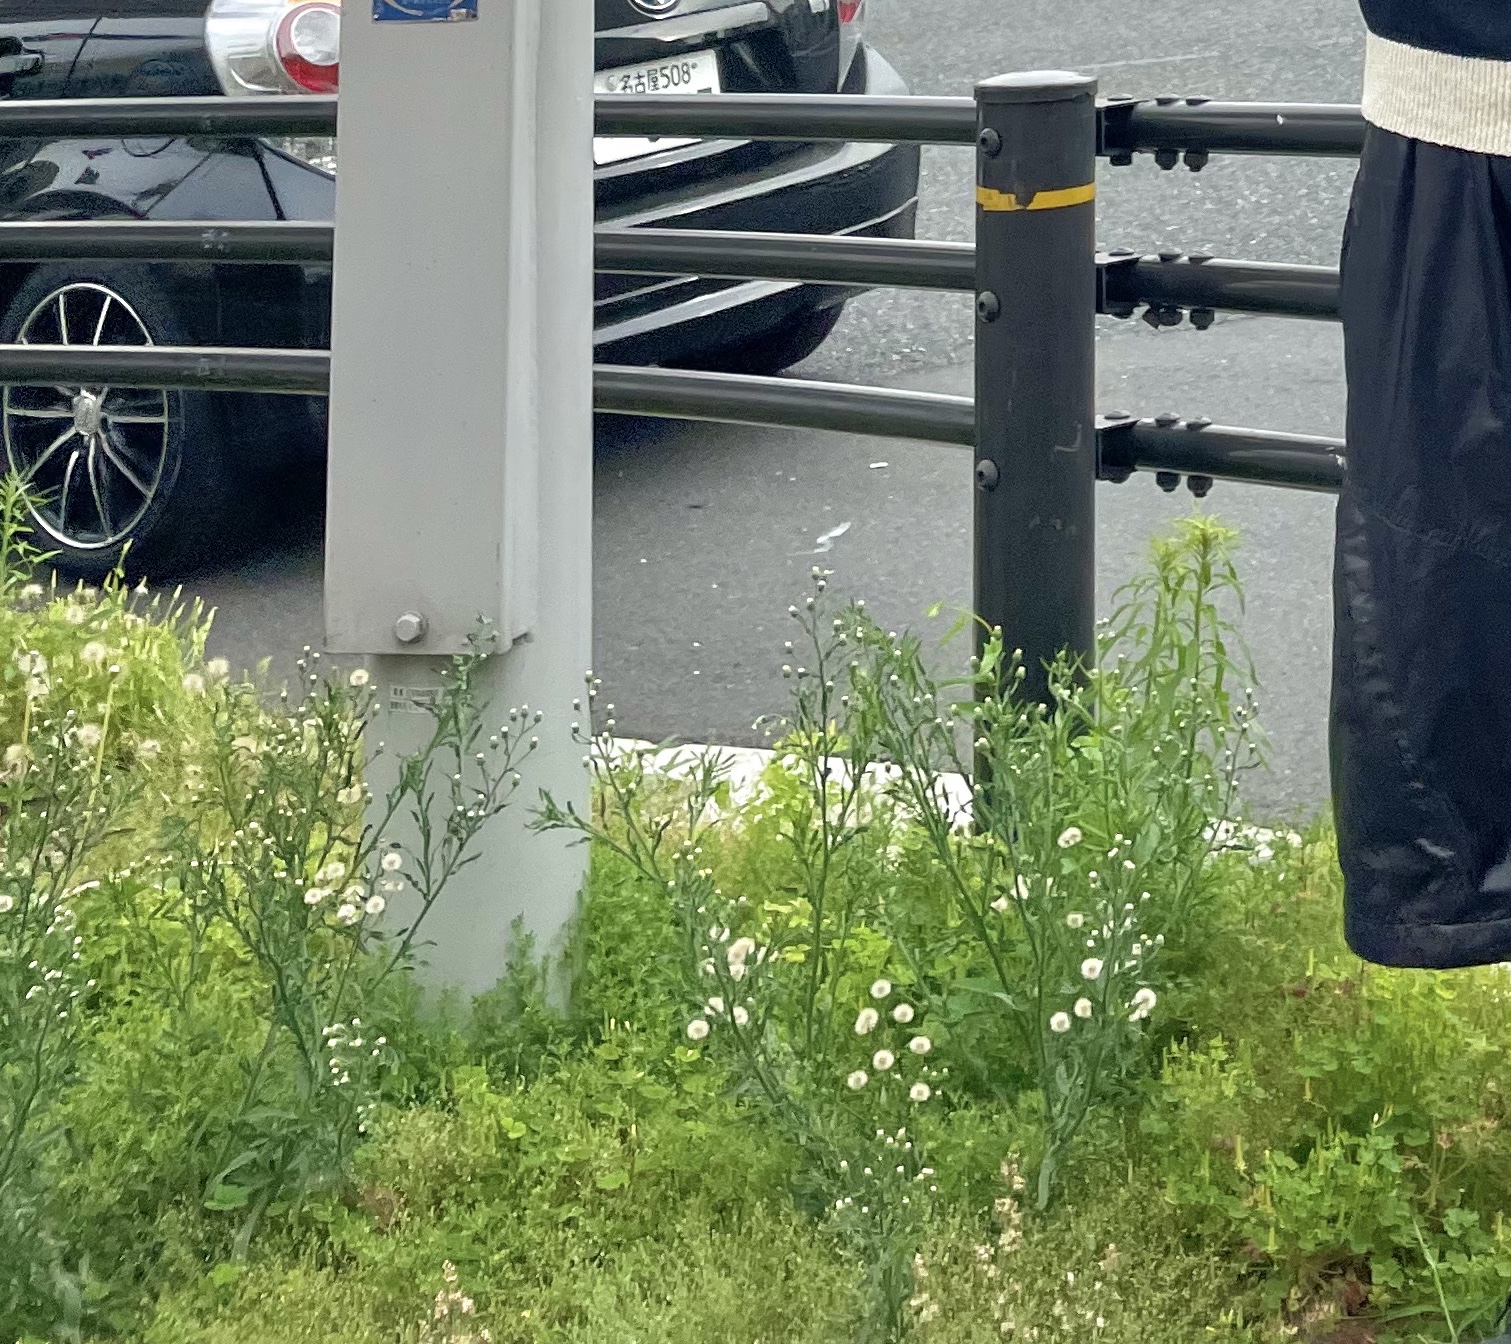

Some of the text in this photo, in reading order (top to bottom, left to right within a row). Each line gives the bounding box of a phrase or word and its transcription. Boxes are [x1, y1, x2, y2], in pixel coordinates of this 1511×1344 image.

[620, 61, 691, 93] 名古屋 508
